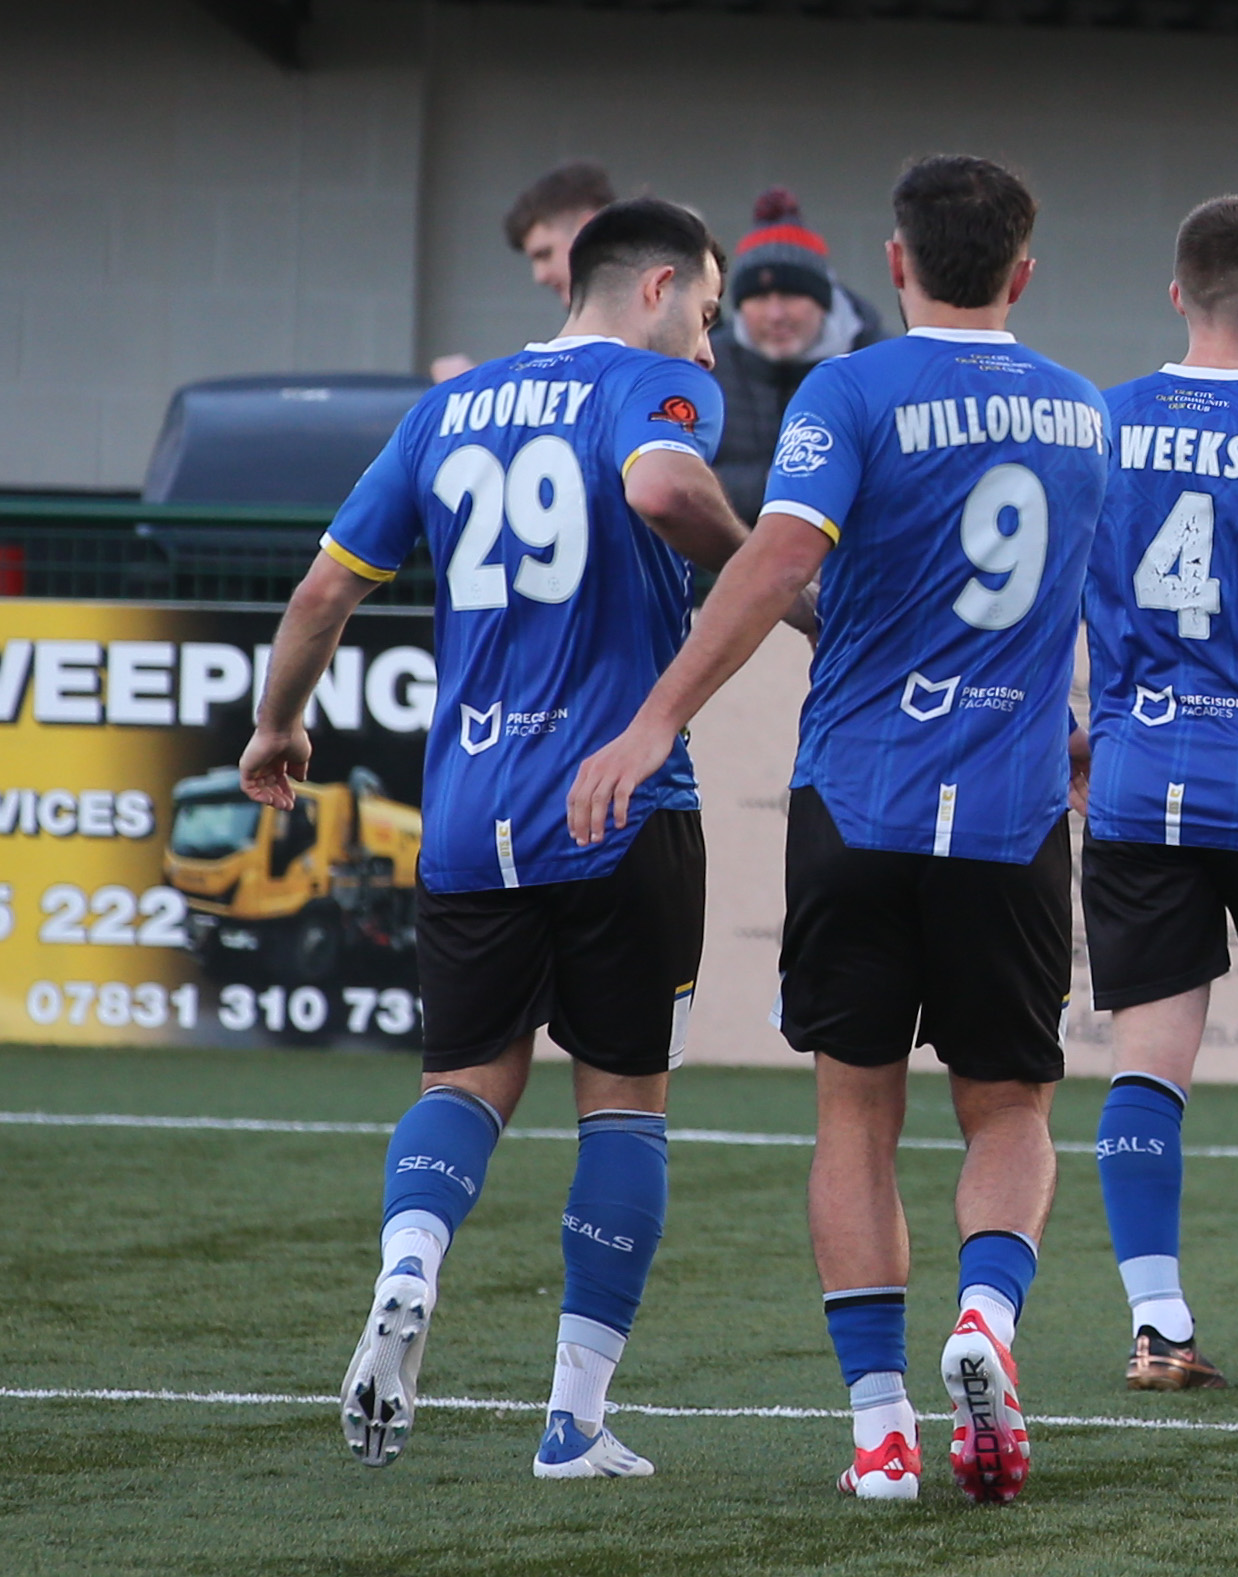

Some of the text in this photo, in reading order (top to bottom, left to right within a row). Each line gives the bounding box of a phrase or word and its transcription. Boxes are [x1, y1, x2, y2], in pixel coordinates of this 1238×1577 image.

[439, 379, 594, 437] MOONEY
[432, 434, 589, 612] 29
[952, 462, 1049, 631] 9
[1133, 490, 1221, 640] 4
[959, 697, 1016, 712] FACADES
[963, 686, 1026, 702] PRECISION
[1181, 705, 1234, 719] FACADES
[505, 721, 557, 737] FACDES
[506, 708, 569, 724] PRECSION
[38, 884, 191, 948] 222
[26, 980, 424, 1034] 07831 310 73
[1097, 1136, 1165, 1161] SEALS
[396, 1155, 477, 1197] SEALS
[561, 1213, 636, 1253] SEALS
